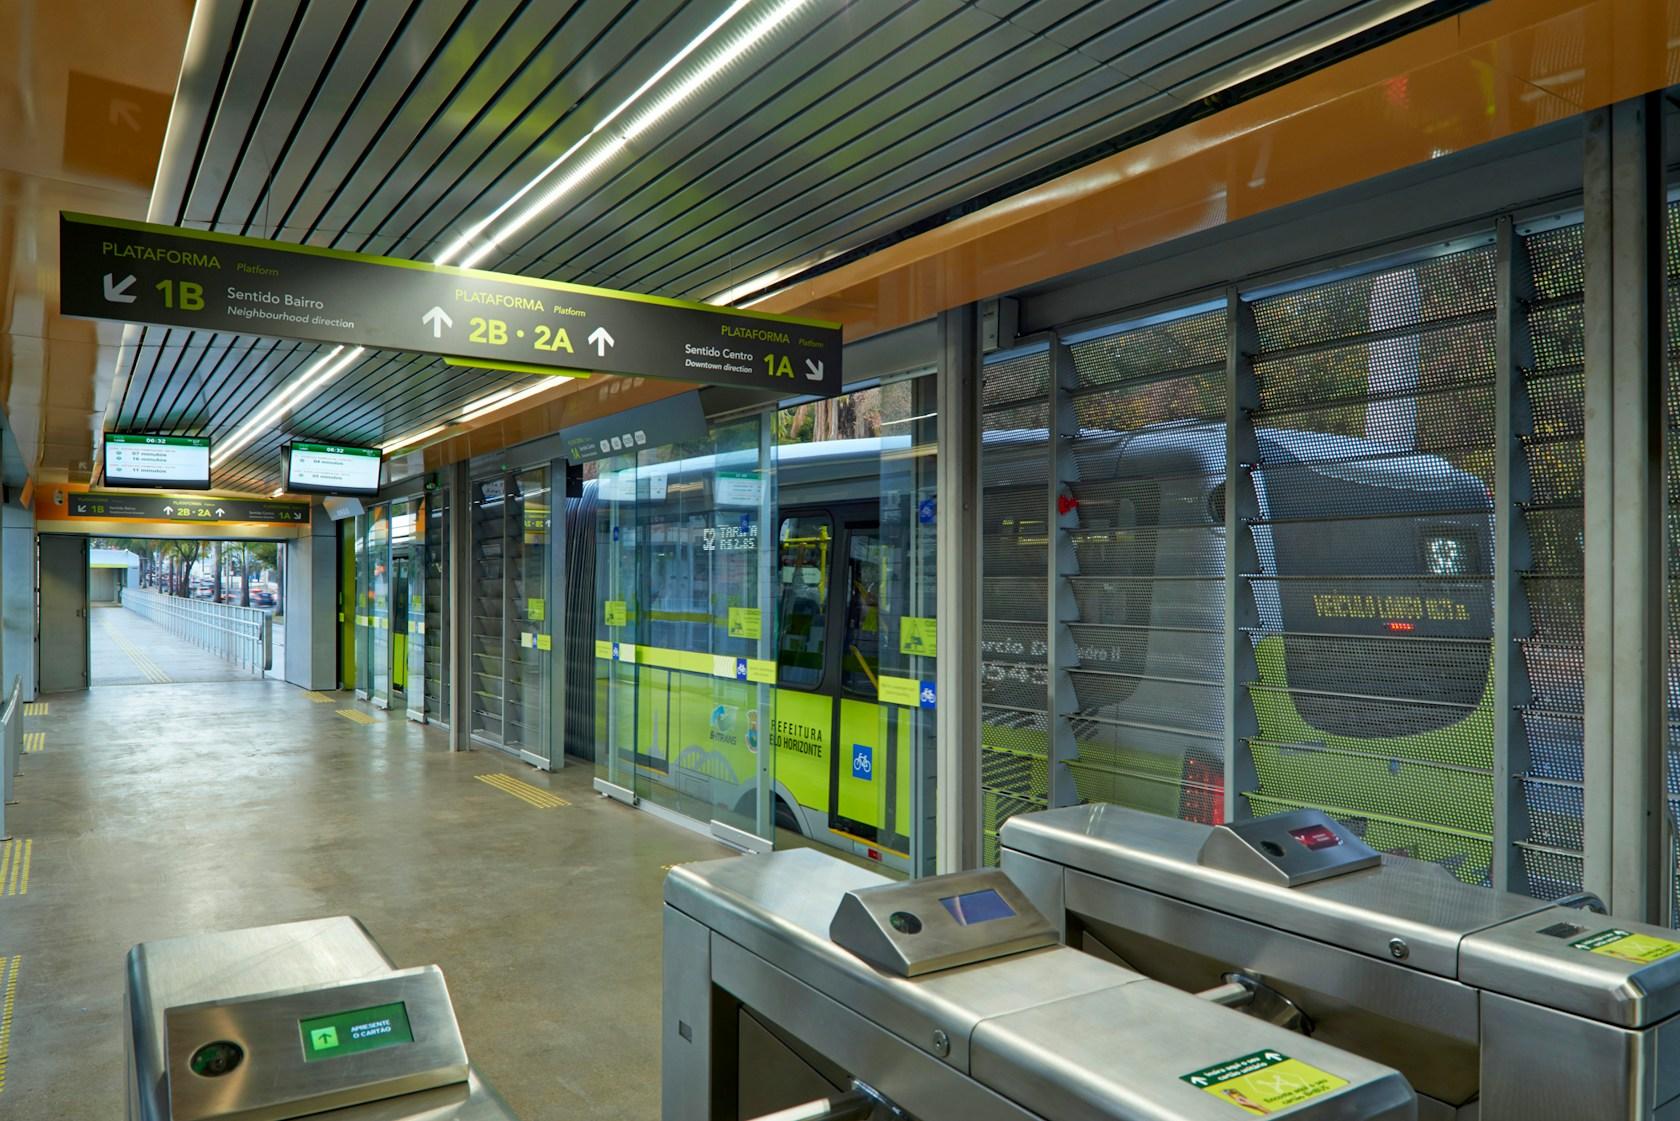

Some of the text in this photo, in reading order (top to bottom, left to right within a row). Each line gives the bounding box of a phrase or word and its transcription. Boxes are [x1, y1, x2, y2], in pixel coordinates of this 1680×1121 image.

[102, 242, 280, 277] PLATAFORMA Platform
[155, 279, 205, 311] 1B
[227, 287, 325, 310] Sentido Bairro
[455, 288, 587, 318] PLATAFORMA Platform
[227, 306, 355, 329] Neighbourhood direction
[468, 318, 574, 354] 2B 2A
[721, 324, 825, 349] PLATAFORMA Platform
[684, 343, 754, 362] Sentido Centro
[685, 359, 753, 375] Downtown direction
[763, 352, 795, 379] 1A
[177, 507, 211, 517] 2B 2A
[770, 719, 823, 743] REFEITURA
[769, 734, 822, 758] ELO HORIZONTE
[351, 1019, 391, 1033] APRESENTE
[361, 1026, 392, 1037] CARTÃO
